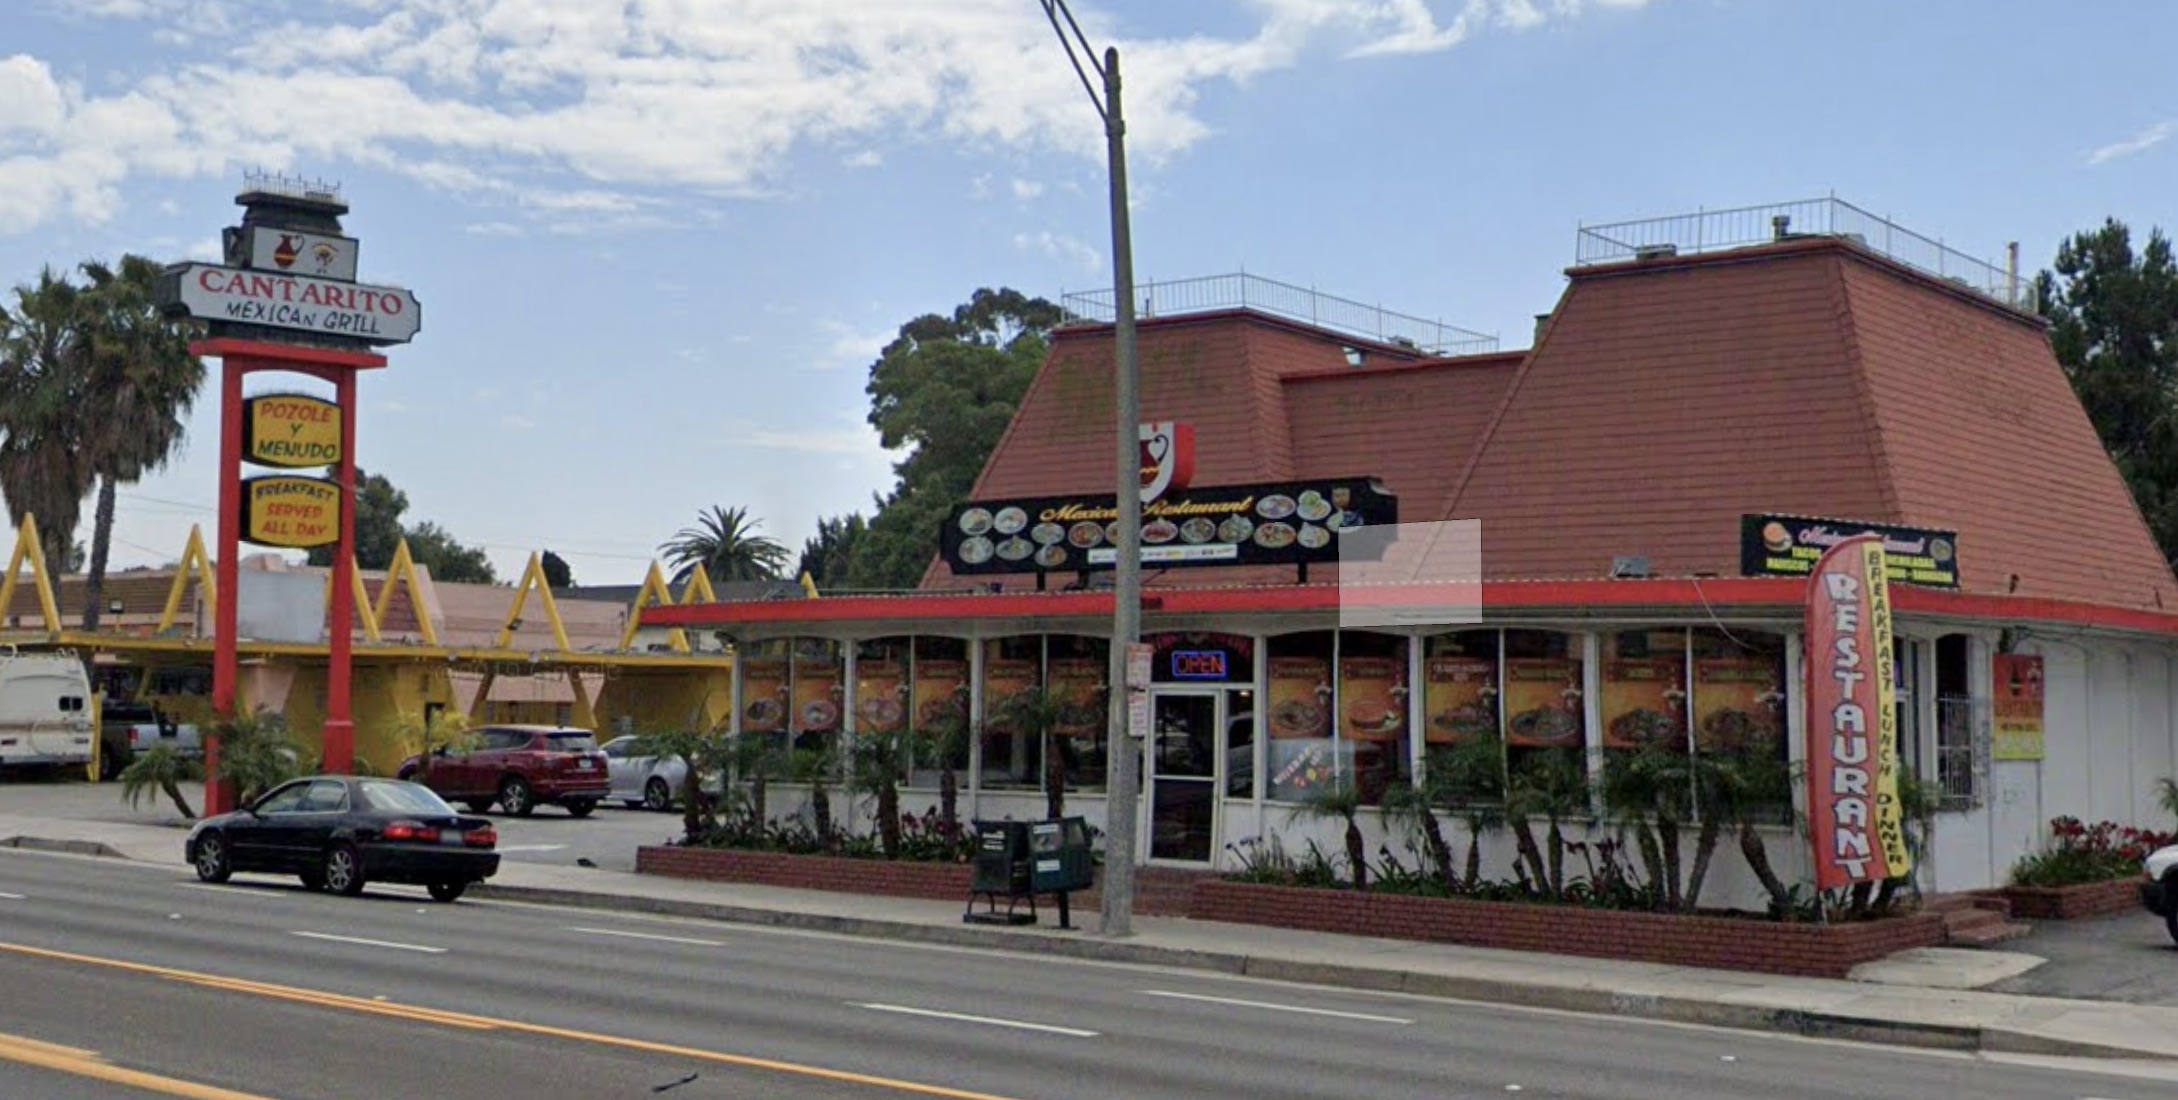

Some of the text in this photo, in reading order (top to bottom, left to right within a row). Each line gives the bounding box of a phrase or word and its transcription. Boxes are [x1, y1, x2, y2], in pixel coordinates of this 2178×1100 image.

[199, 269, 402, 316] CANTARITO
[225, 301, 381, 335] MEXICAN GRILL
[260, 402, 333, 423] POZOLE
[290, 423, 303, 436] Y
[257, 439, 337, 459] MENUDO
[255, 482, 335, 500] BREAKFAST
[266, 502, 323, 517] SERVED
[1040, 496, 1253, 521] Mexica Restaurant
[261, 520, 327, 537] ALL DAY
[1868, 551, 1892, 692] BREAKFAST
[1176, 655, 1226, 673] OPEN
[1824, 572, 1872, 879] RESTAURANT
[1879, 703, 1893, 777] LUNCH
[1877, 793, 1903, 865] DINNER
